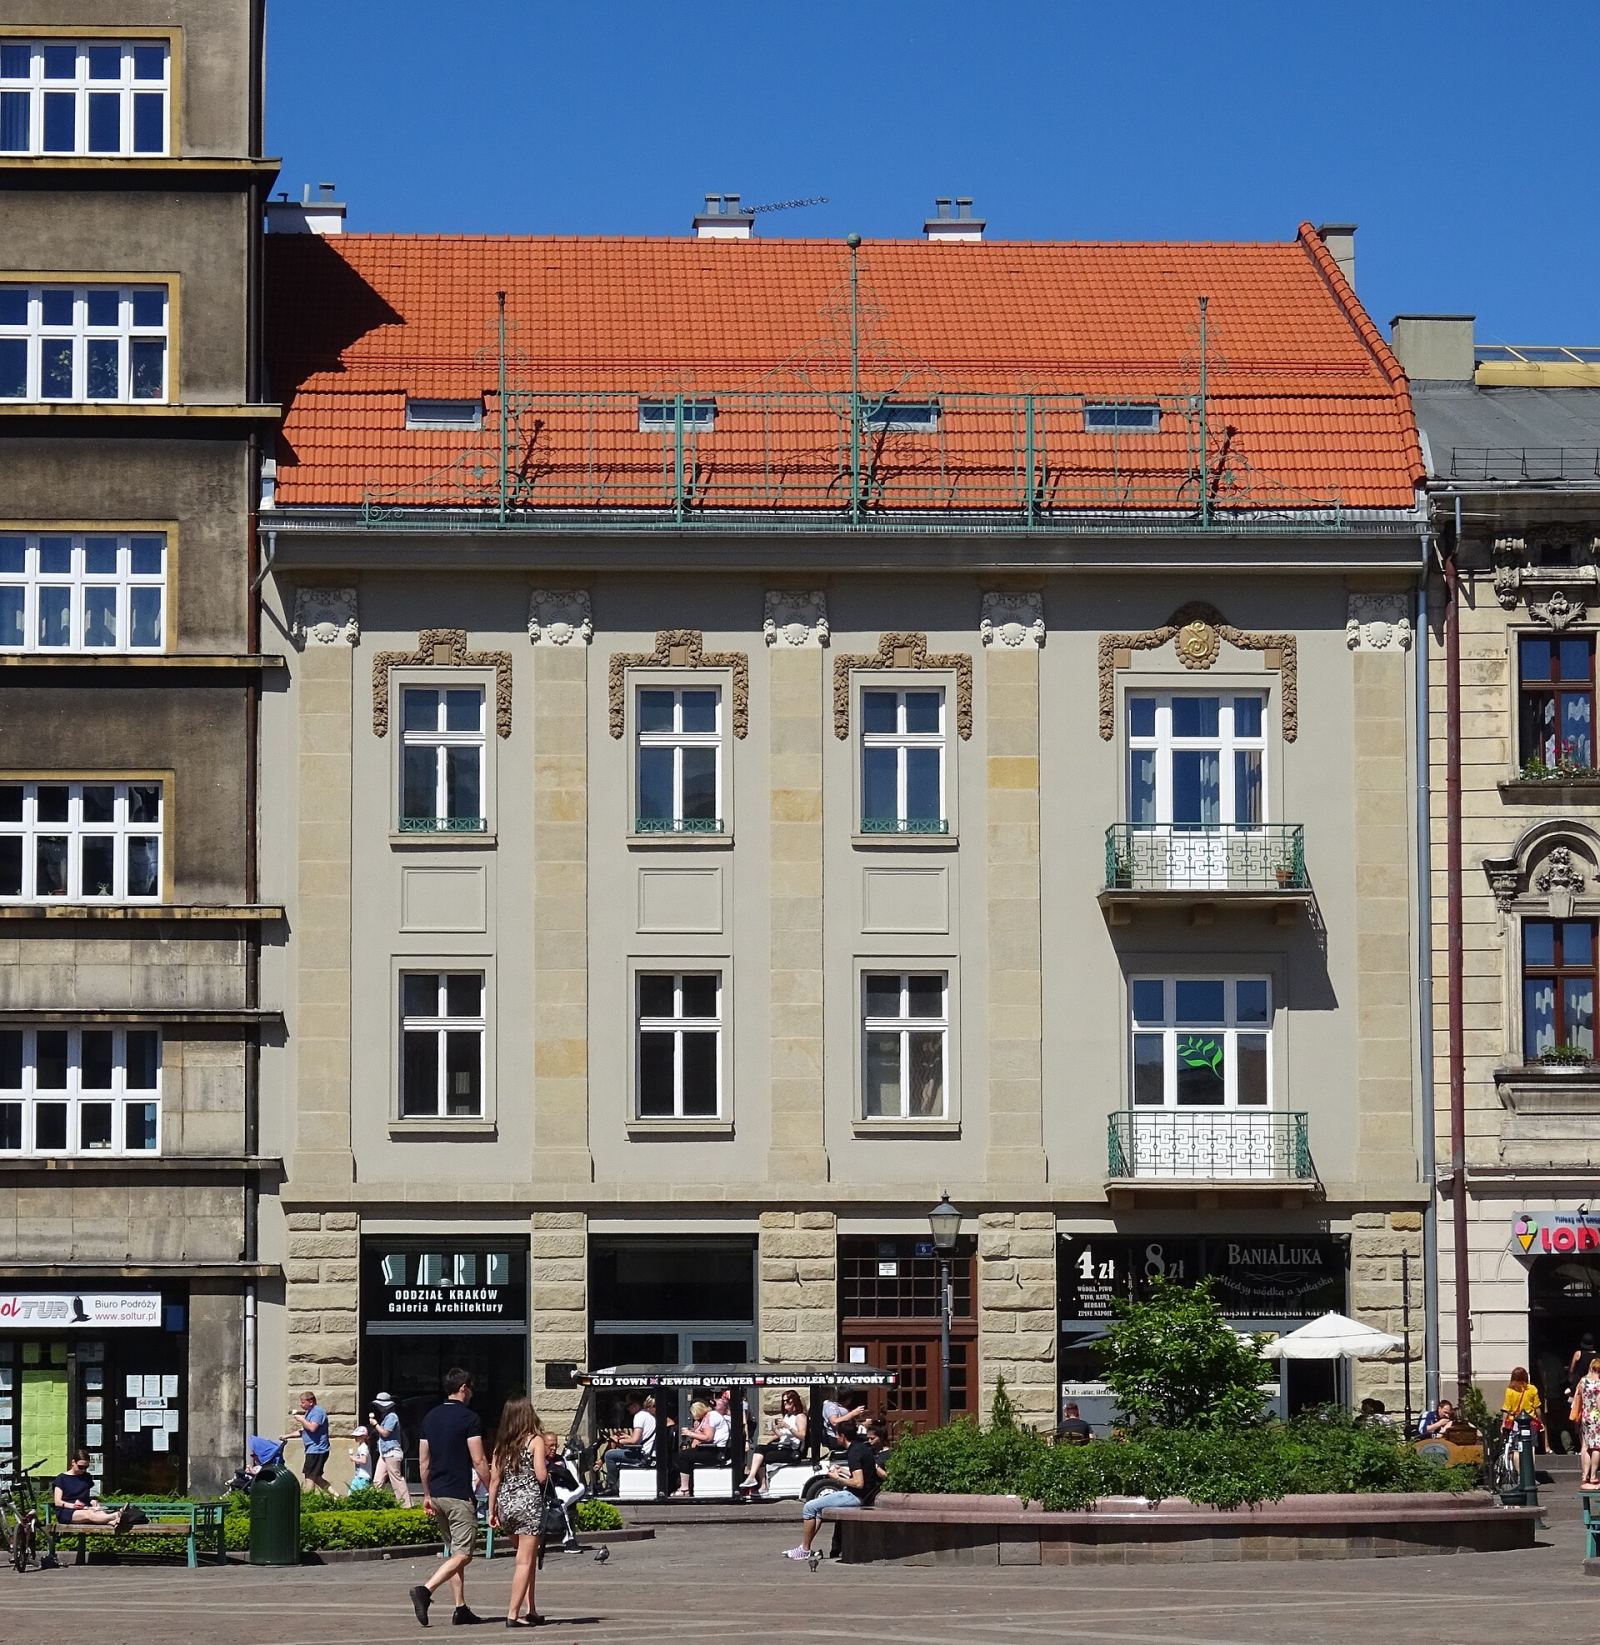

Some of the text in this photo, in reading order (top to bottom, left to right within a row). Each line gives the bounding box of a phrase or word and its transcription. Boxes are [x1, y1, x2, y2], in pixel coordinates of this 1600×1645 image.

[1541, 1226, 1600, 1254] LOD
[1075, 1245, 1115, 1279] 4 zł
[1144, 1244, 1184, 1279] 8 zł
[395, 1288, 498, 1300] ODDZIAŁ KRAKÓW
[95, 1299, 157, 1311] Biuro Podróży
[388, 1302, 503, 1313] Galeria Architektury
[95, 1312, 157, 1321] www.soltur.pl
[592, 1377, 648, 1386] OLD TOWN
[660, 1377, 754, 1386] JEWISH QUARTER
[766, 1375, 885, 1385] SCHINDLER'S FACTORY
